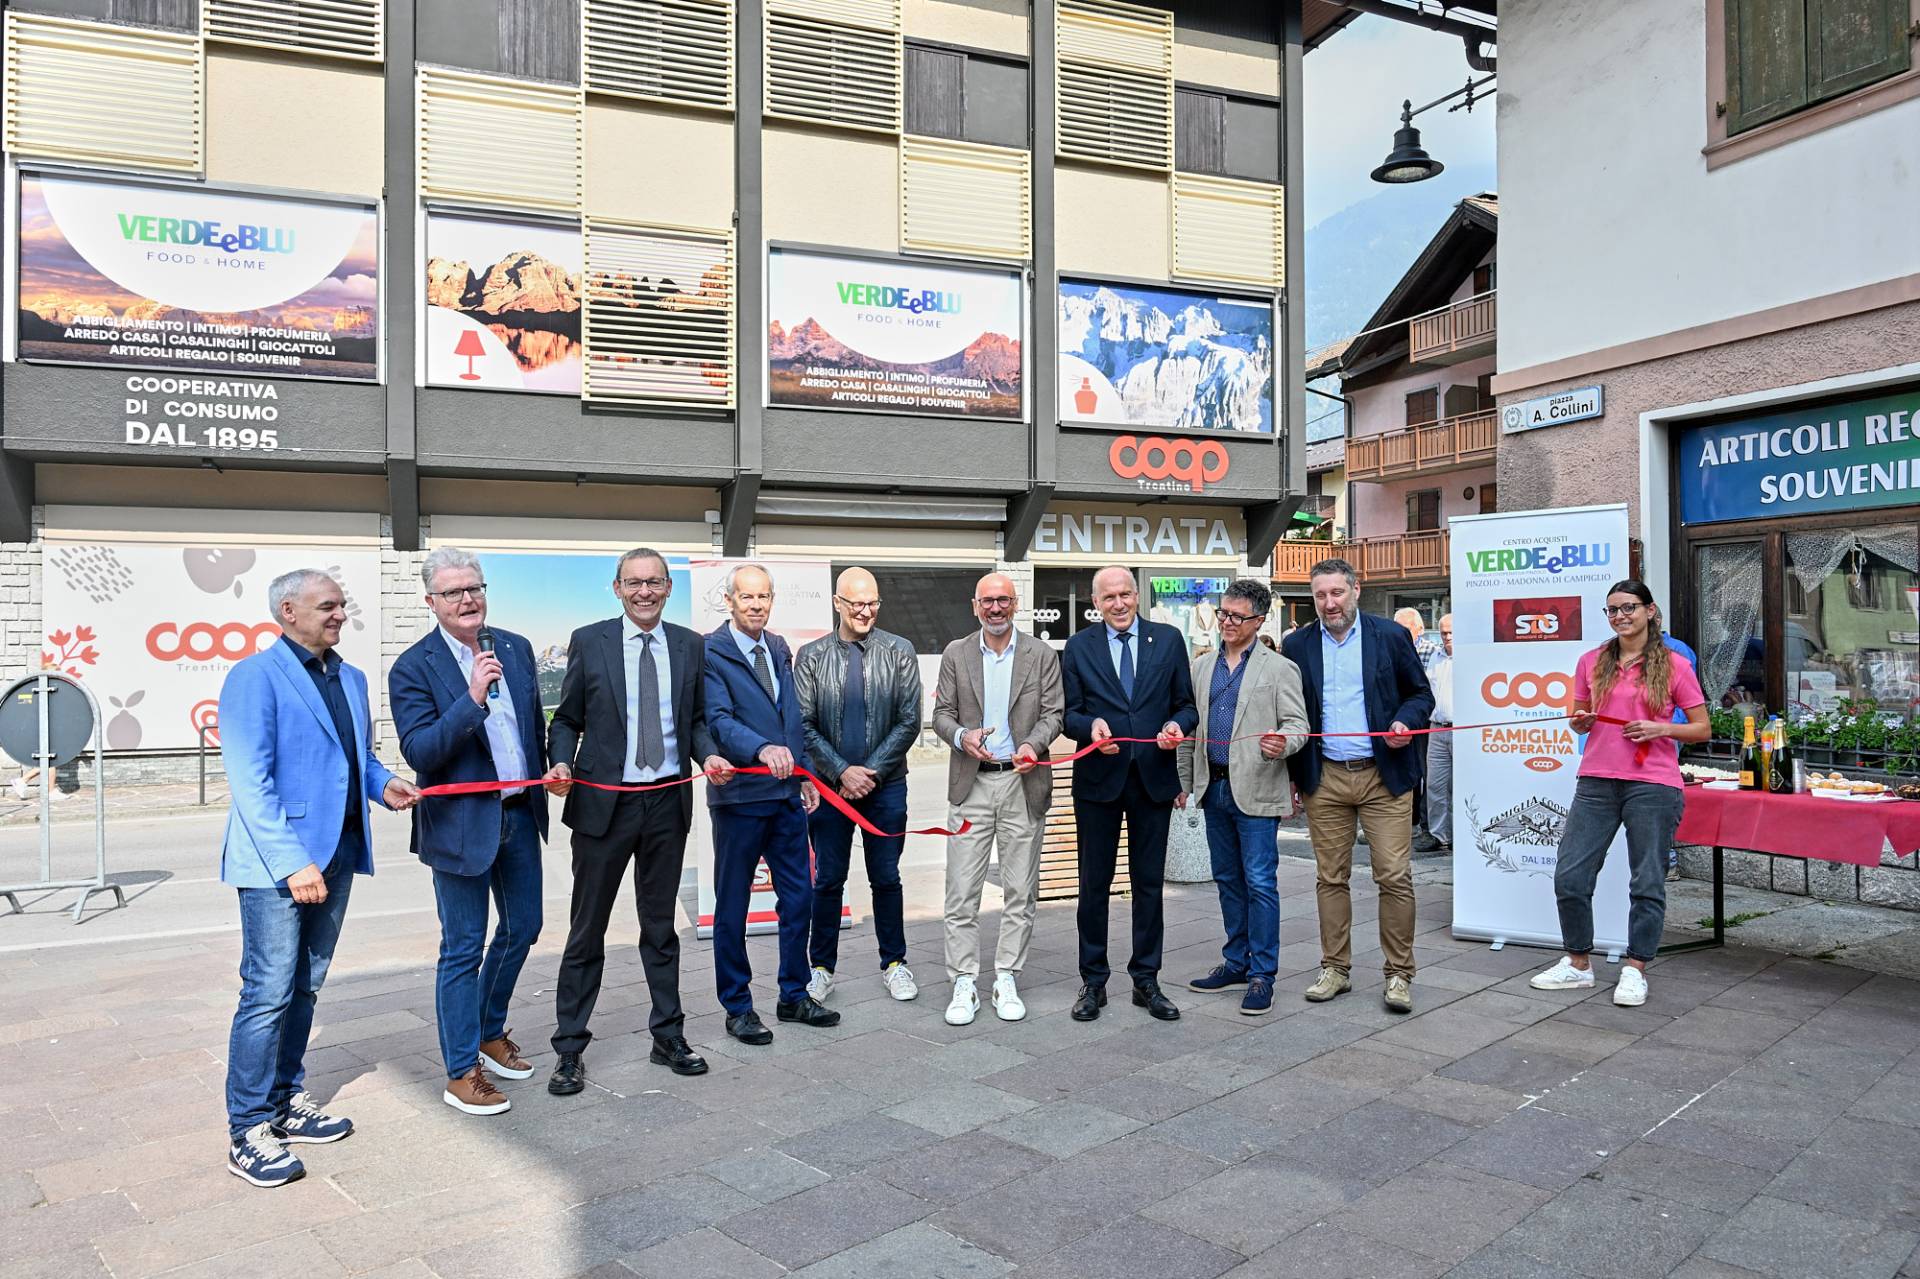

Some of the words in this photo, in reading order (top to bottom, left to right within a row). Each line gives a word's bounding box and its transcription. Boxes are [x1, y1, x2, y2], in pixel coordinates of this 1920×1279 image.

[147, 252, 196, 264] FOOD
[217, 258, 265, 270] HOME
[73, 316, 184, 330] ABBIGLIAMENTO
[193, 323, 241, 335] INTIMO
[251, 326, 331, 342] PROFUMERIA
[857, 313, 893, 324] FOOD
[907, 318, 942, 328] HOME
[64, 328, 119, 341] ARREDO
[122, 331, 159, 343] CASA
[169, 335, 249, 349] CASALINGHI
[258, 341, 335, 355] GIOCATTOLI
[109, 345, 172, 358] ARTICOLI
[175, 348, 228, 361] REGALO
[237, 353, 300, 366] SOUVENIR
[126, 376, 278, 399] COOPERATIVA
[806, 366, 883, 380] ABBIGLIAMENTO
[890, 372, 925, 384] INTIMO
[931, 375, 988, 388] PROFUMERIA
[800, 377, 839, 388] ARREDO
[841, 380, 867, 390] CASA
[873, 383, 929, 395] CASALINGHI
[936, 388, 990, 400] GIOCATTOLI
[126, 398, 148, 415] DI
[164, 401, 278, 421] CONSUMO
[832, 391, 875, 402] ARTICOLI
[877, 394, 915, 405] REGALO
[921, 397, 965, 409] SOUVENIR
[1550, 395, 1574, 406] piazza
[1533, 410, 1545, 422] A.
[1550, 400, 1593, 418] Collini
[126, 421, 196, 447] DAL
[203, 427, 278, 451] 1895
[1699, 419, 1849, 468] ARTICOLI
[1137, 480, 1190, 492] Trentino
[1035, 513, 1235, 555] ENTRATA
[1503, 538, 1532, 546] CENTRO
[1533, 536, 1568, 544] ACQUISTI
[1466, 579, 1500, 588] PINZOLO
[1507, 576, 1552, 585] MADONNA
[1563, 573, 1611, 583] CAMPIGLIO
[176, 663, 229, 672] Trentin
[1481, 672, 1575, 716] coo
[1482, 728, 1574, 744] FAMIGLIA
[1482, 744, 1574, 755] COOPERATIVA
[1490, 795, 1538, 825] FAMIGLIA
[1521, 855, 1539, 864] DAL
[1541, 856, 1556, 865] 189
